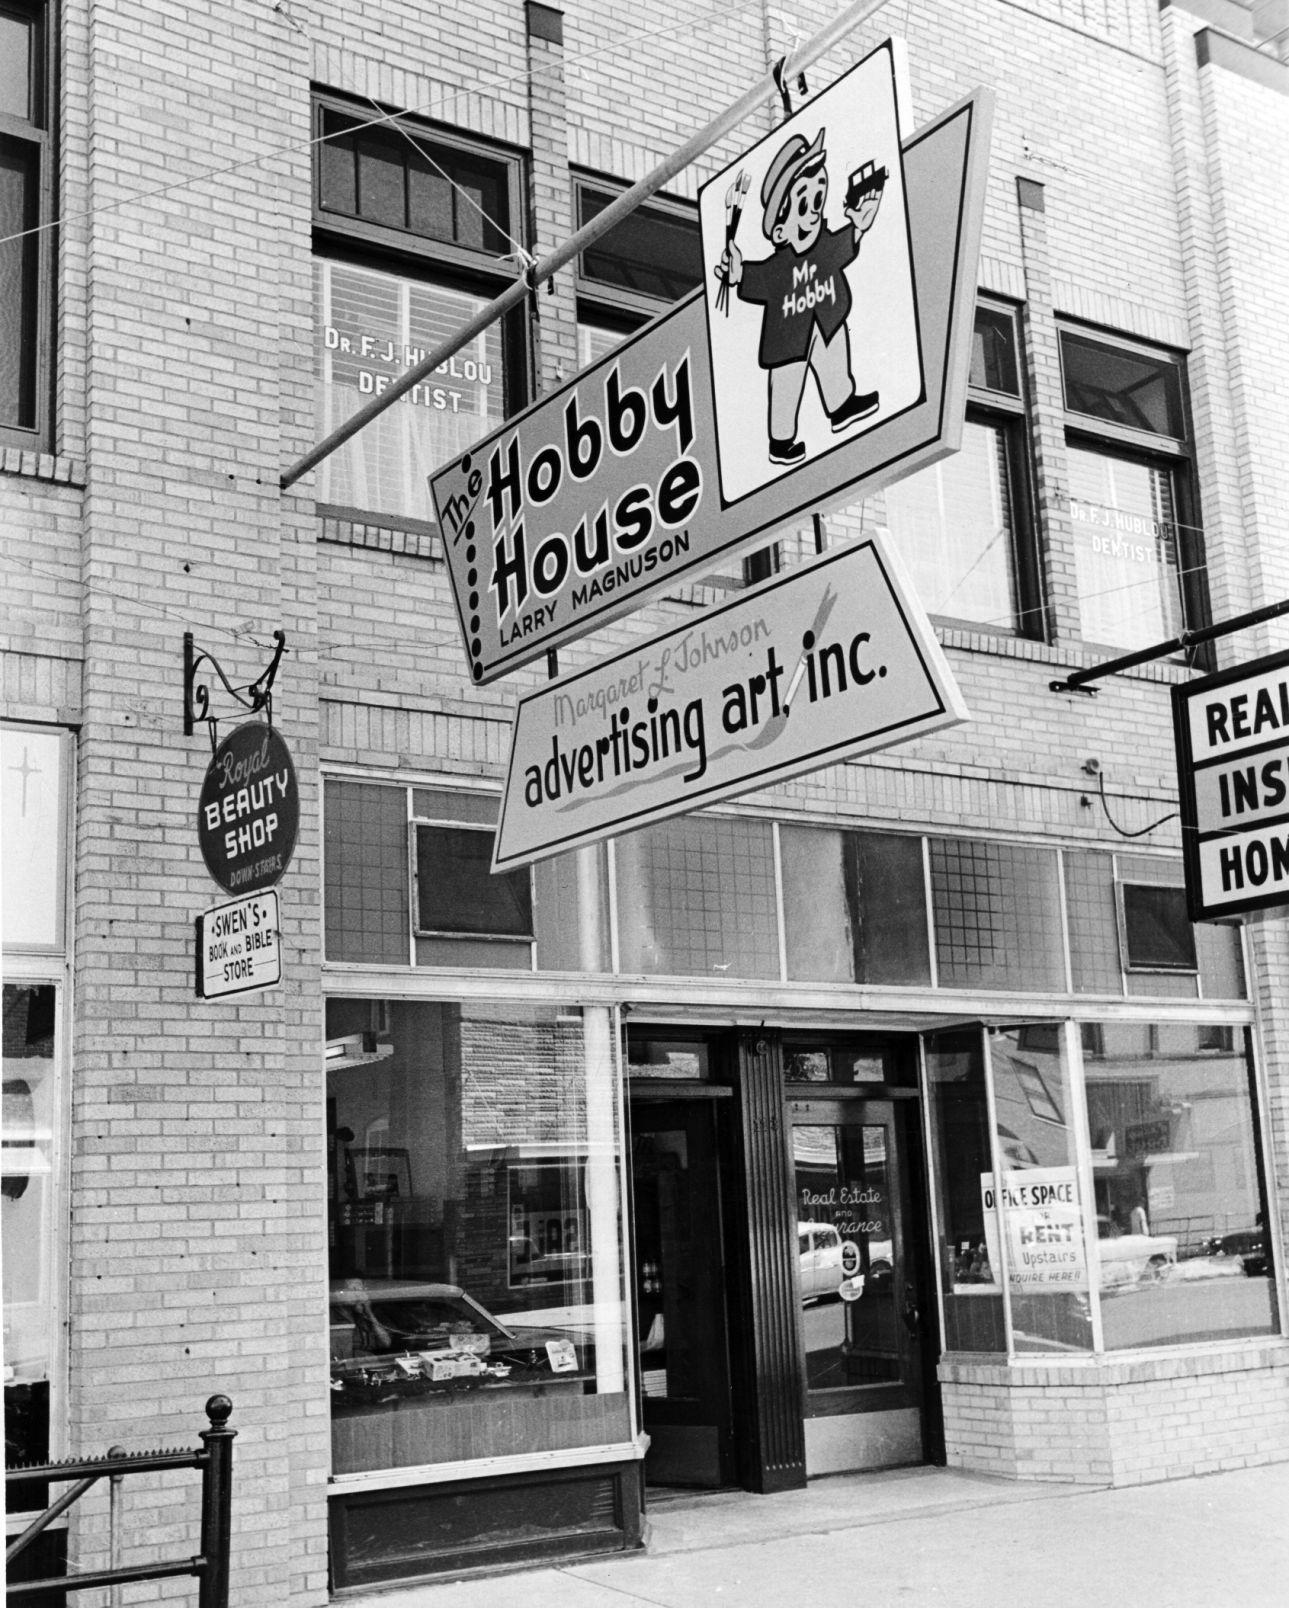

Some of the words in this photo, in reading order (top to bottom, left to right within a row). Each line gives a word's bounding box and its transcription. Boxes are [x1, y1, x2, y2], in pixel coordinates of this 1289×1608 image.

[782, 276, 836, 318] Hobby
[359, 371, 462, 413] DETIST
[441, 469, 483, 533] The
[484, 346, 695, 539] Hobby
[488, 456, 701, 628] House
[500, 600, 558, 647] LARRY
[572, 530, 690, 610] MAGNUSON
[554, 660, 649, 727] Margaret
[675, 618, 772, 672] Johnson
[524, 697, 707, 808] advertising
[803, 630, 887, 703] inc.
[217, 733, 270, 789] Royal
[204, 768, 288, 830] BEAUTY
[1218, 757, 1289, 818] INS
[225, 812, 278, 859] SHOP
[209, 940, 228, 963] BOOK
[245, 928, 272, 952] BIBLE
[224, 957, 254, 982] STORE
[802, 1187, 837, 1205] Real
[840, 1187, 882, 1204] Estate
[985, 1187, 1027, 1209] OFICE
[1031, 1184, 1073, 1205] SPACE
[1022, 1251, 1076, 1268] Upstairs
